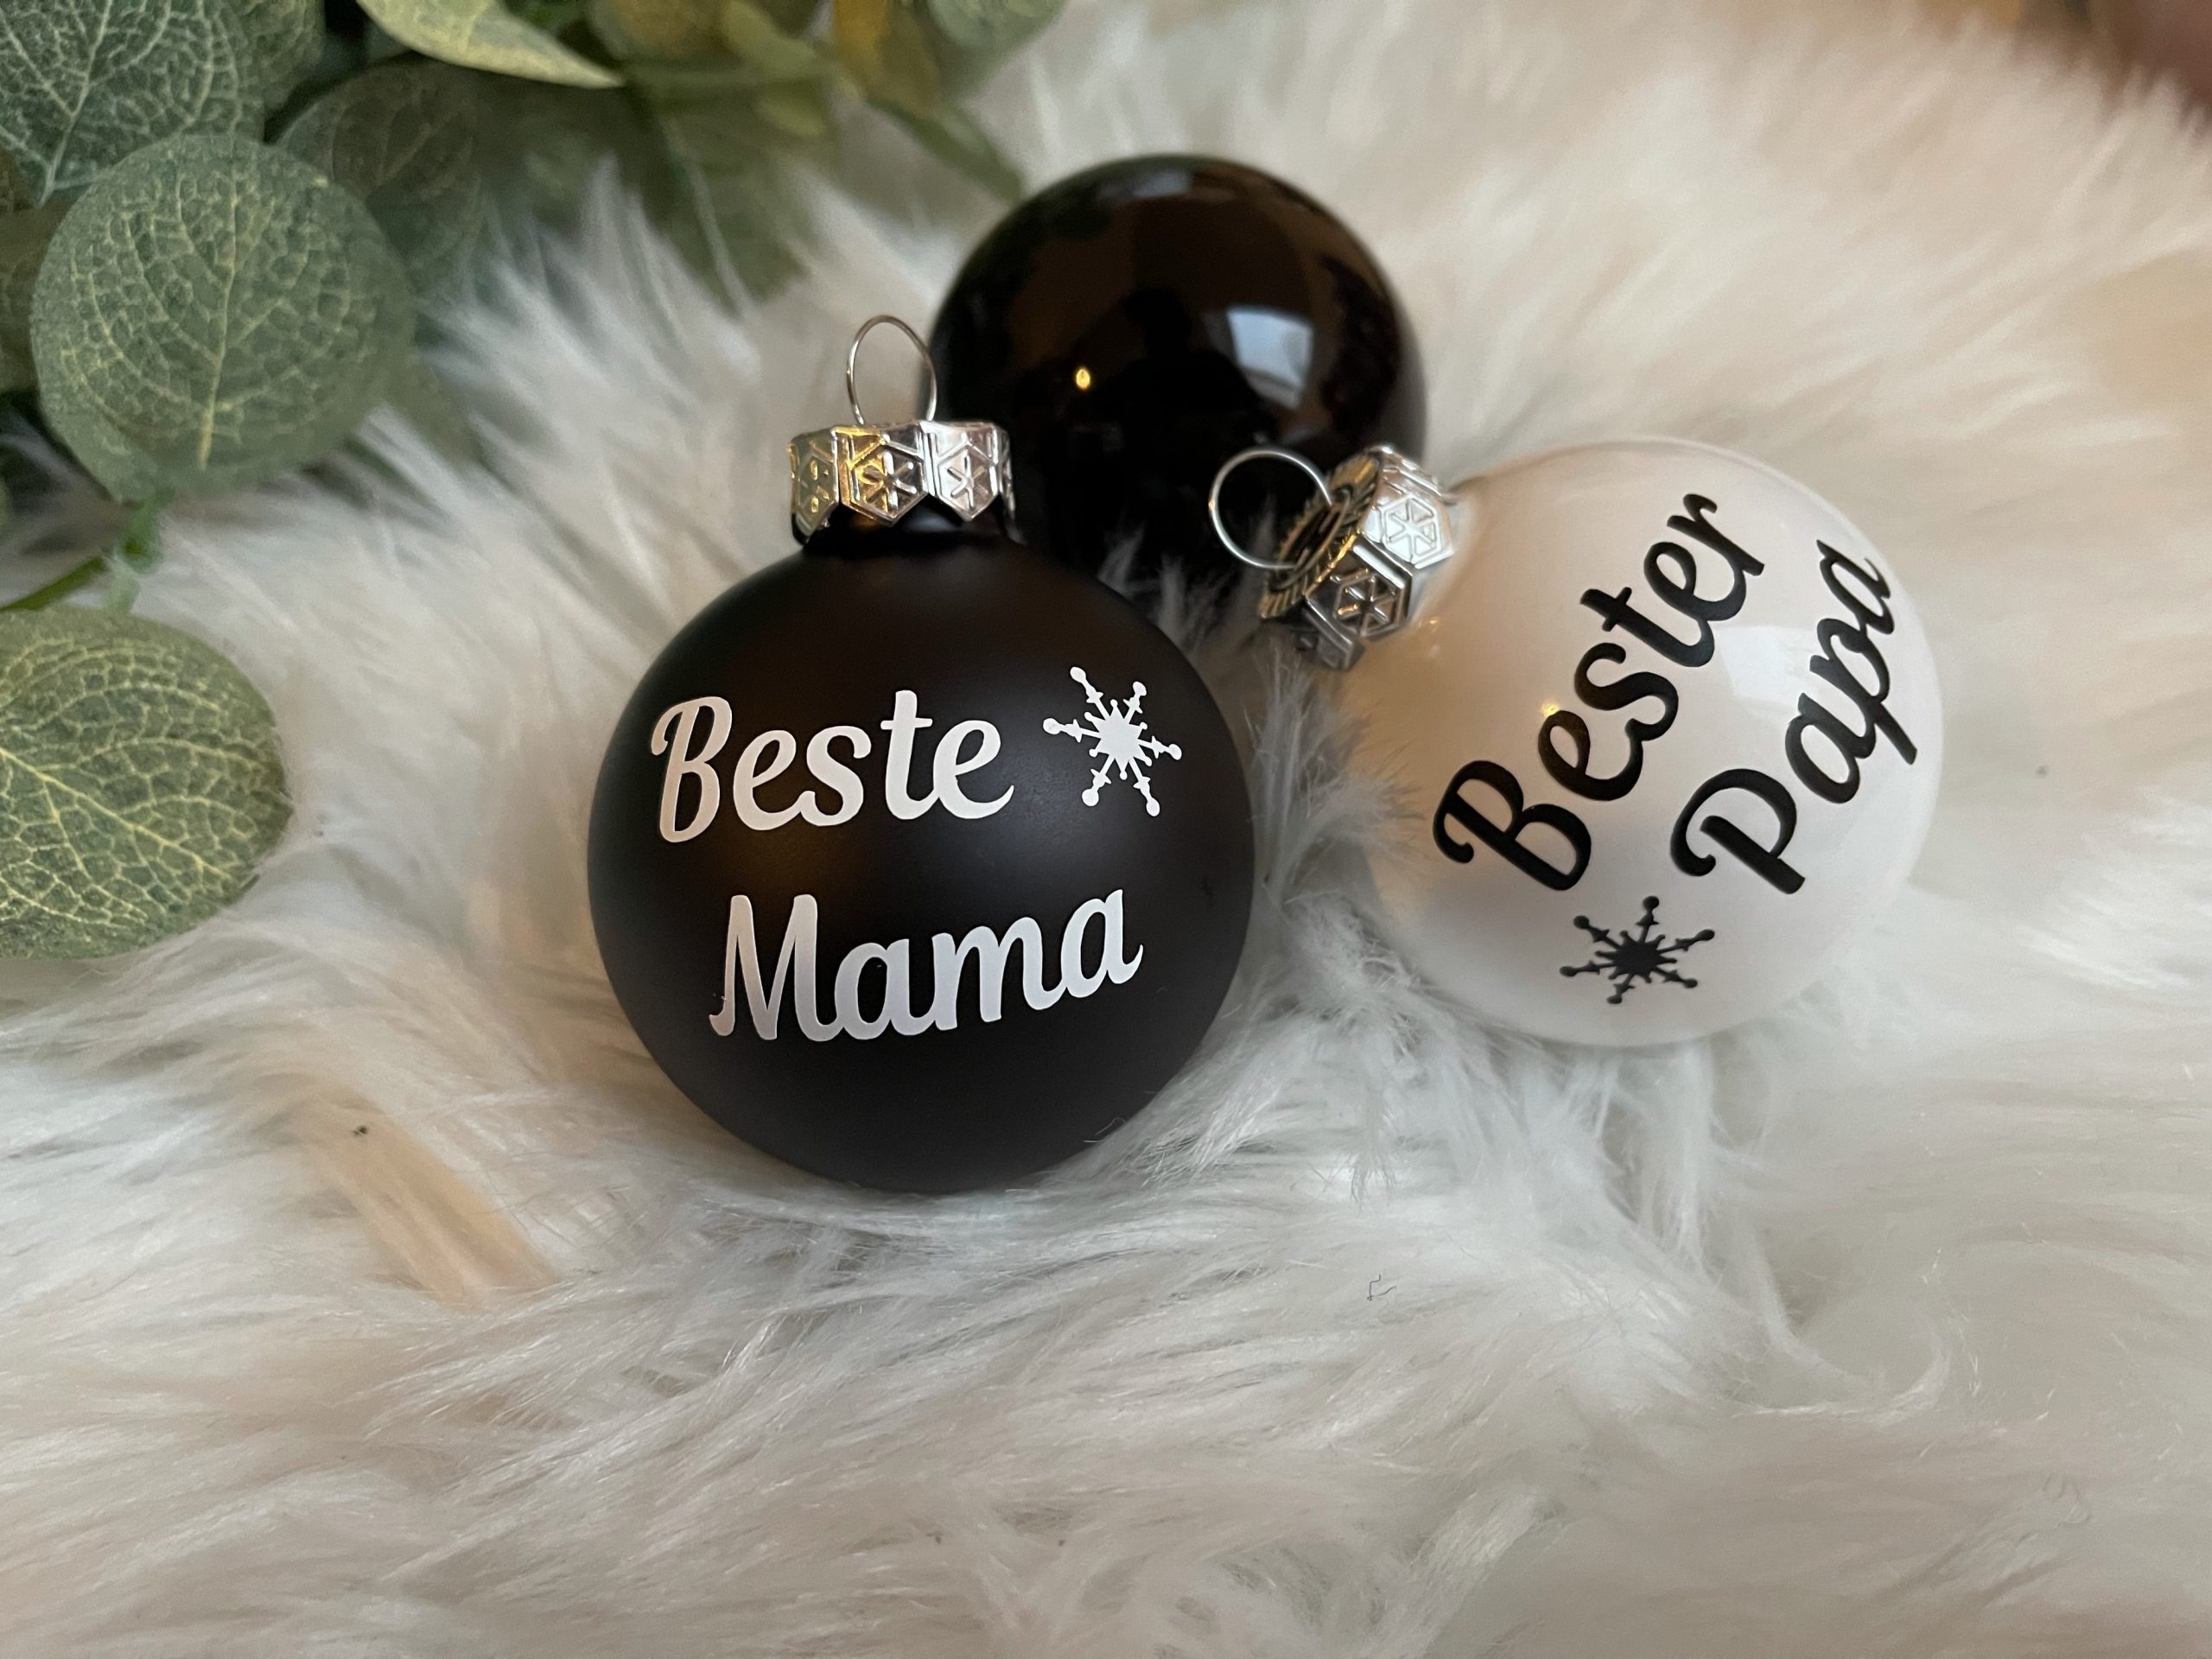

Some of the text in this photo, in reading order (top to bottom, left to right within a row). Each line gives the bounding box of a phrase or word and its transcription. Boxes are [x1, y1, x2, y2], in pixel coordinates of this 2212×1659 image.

[651, 690, 1015, 843] Beste
[1432, 493, 1765, 892] Bester
[1669, 539, 1918, 894] Papa
[709, 888, 1144, 1043] Mama
